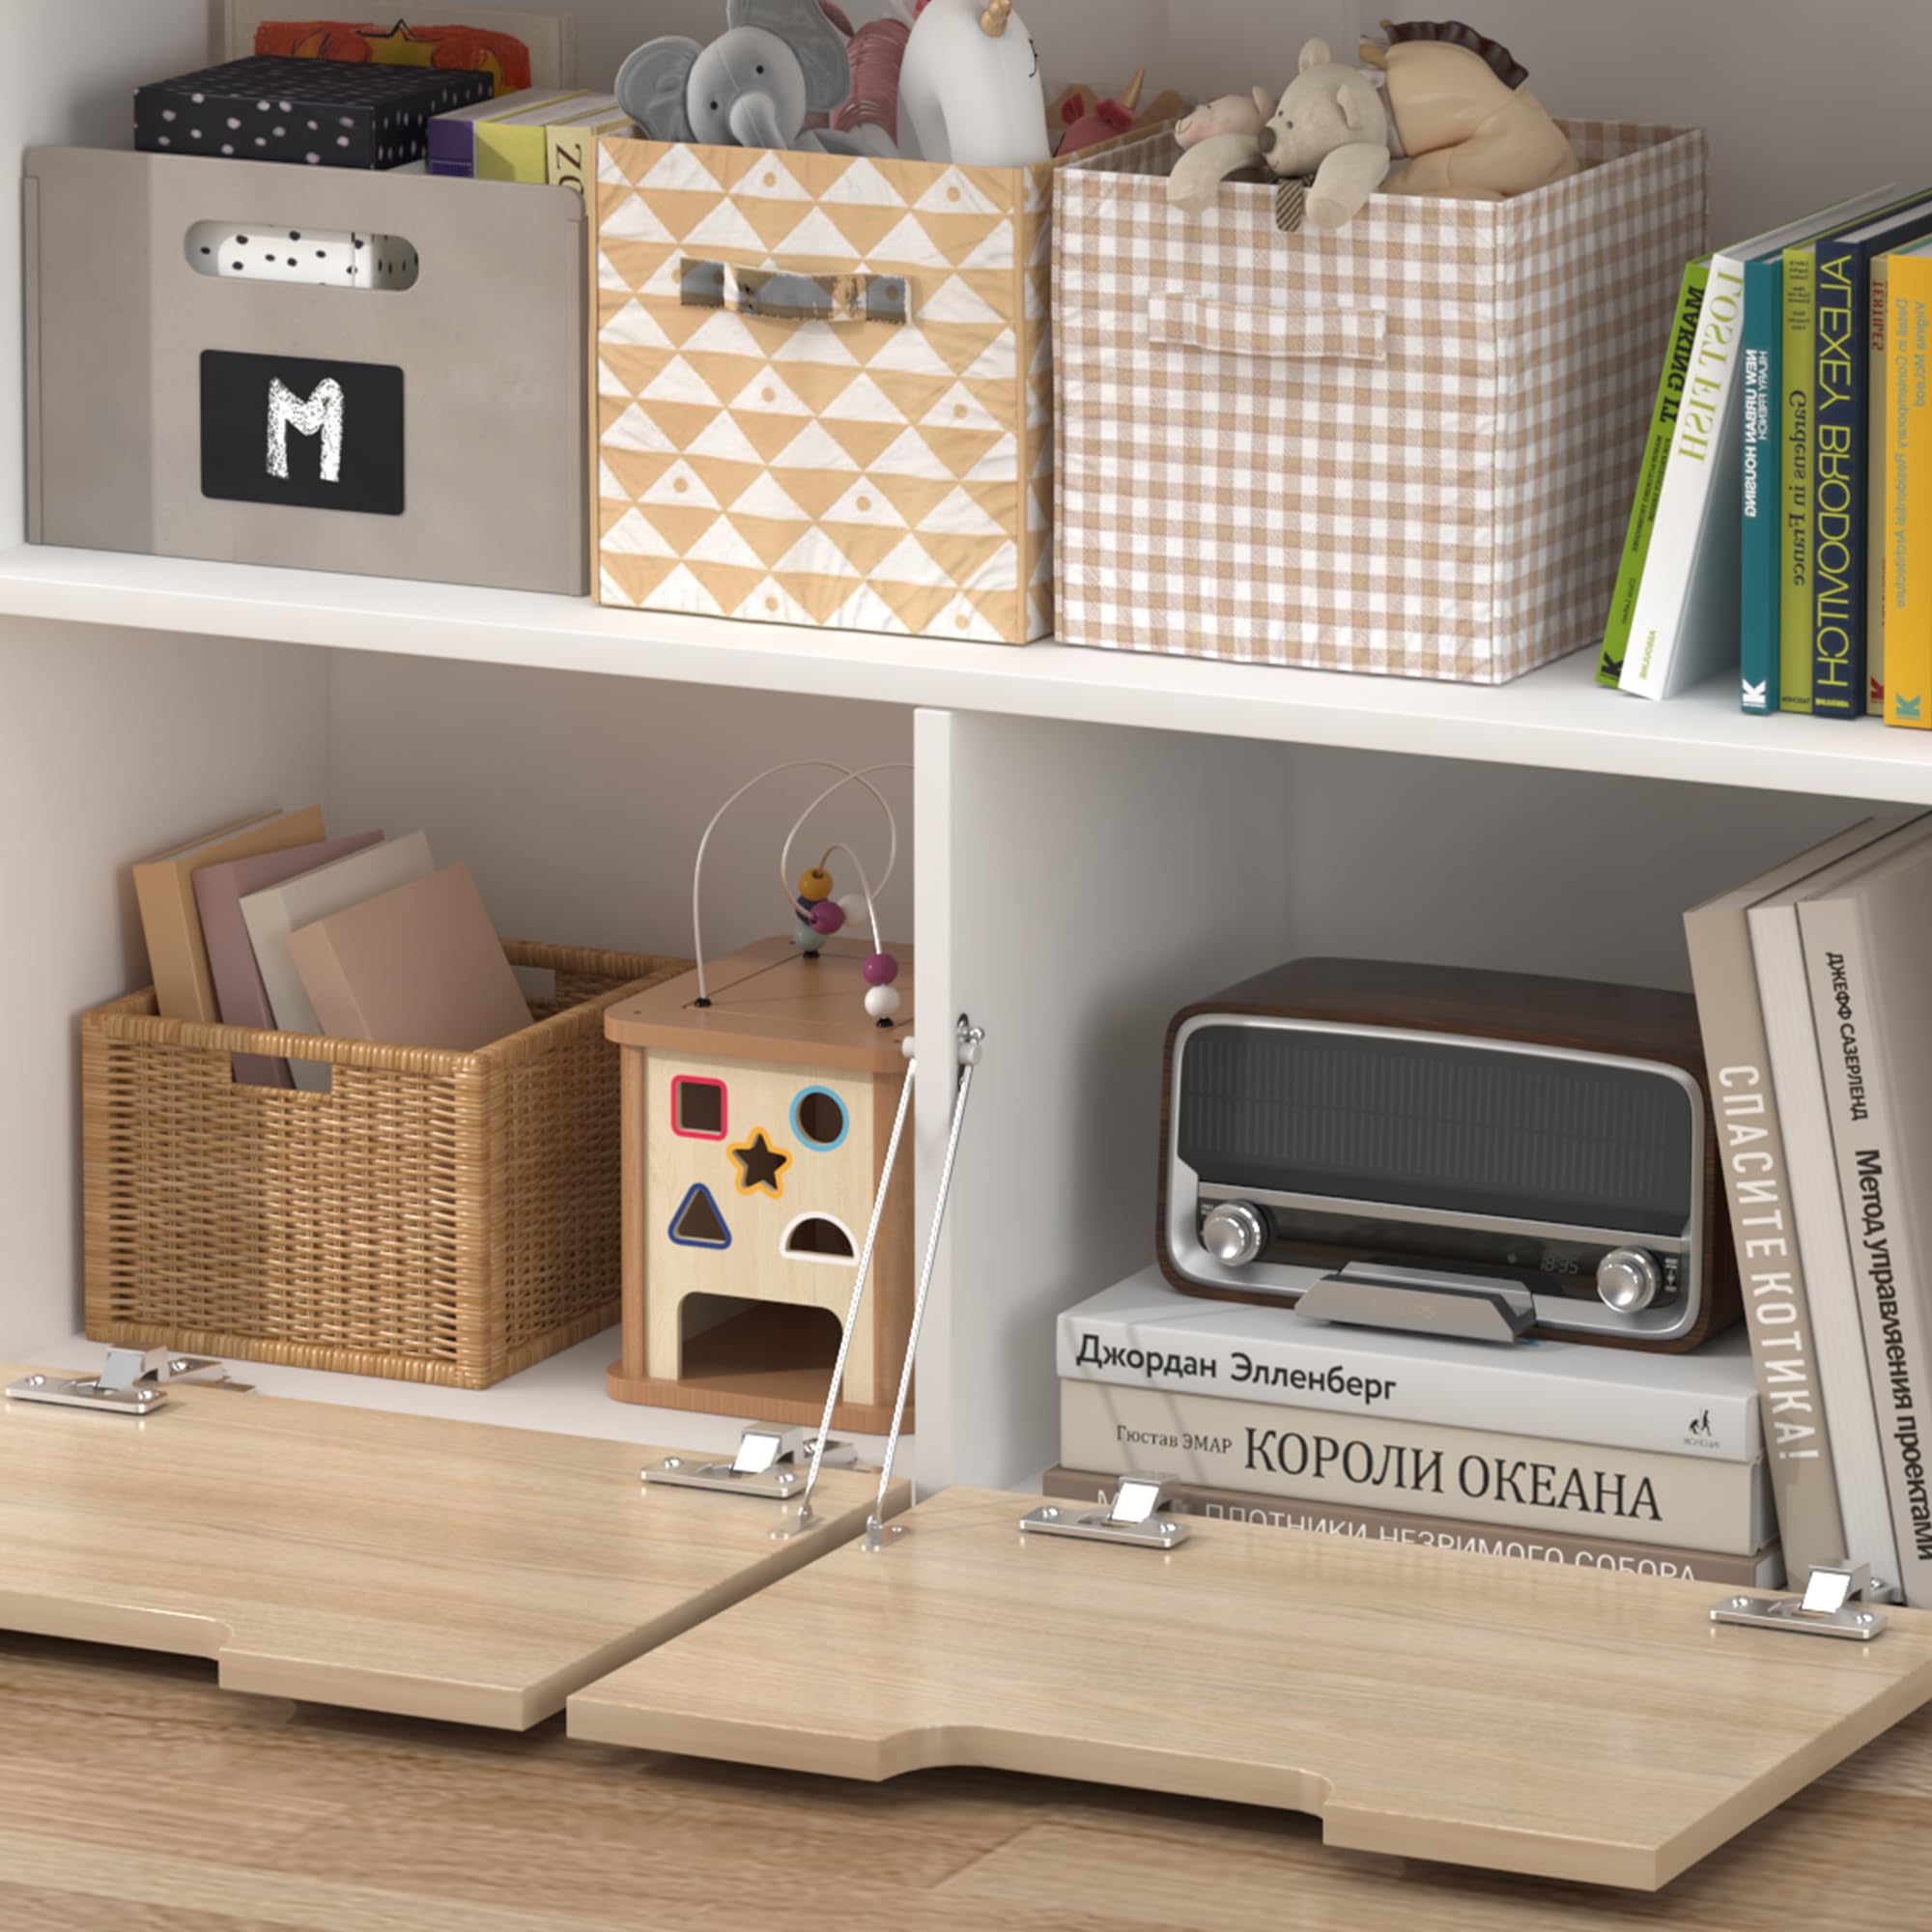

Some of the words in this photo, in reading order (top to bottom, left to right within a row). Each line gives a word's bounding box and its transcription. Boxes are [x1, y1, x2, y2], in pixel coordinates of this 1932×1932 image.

[266, 377, 344, 482] M
[1825, 952, 1853, 1020] ДЖЕФФ
[1840, 1023, 1868, 1122] САЗЕРЛЕНД
[1719, 1065, 1787, 1259] СПАСИТЕ
[1855, 1150, 1885, 1236] Метод
[1076, 1333, 1217, 1378] Джордан
[1230, 1351, 1396, 1404] Элленберг
[1751, 1272, 1819, 1460] КОТИКА!
[1863, 1238, 1915, 1409] управления
[1117, 1424, 1179, 1448] Гюстав
[1182, 1433, 1233, 1455] ЭМАР
[1245, 1427, 1444, 1494] КОРОЛИ
[1459, 1454, 1662, 1521] ОКЕАНА
[1893, 1415, 1932, 1560] проектами
